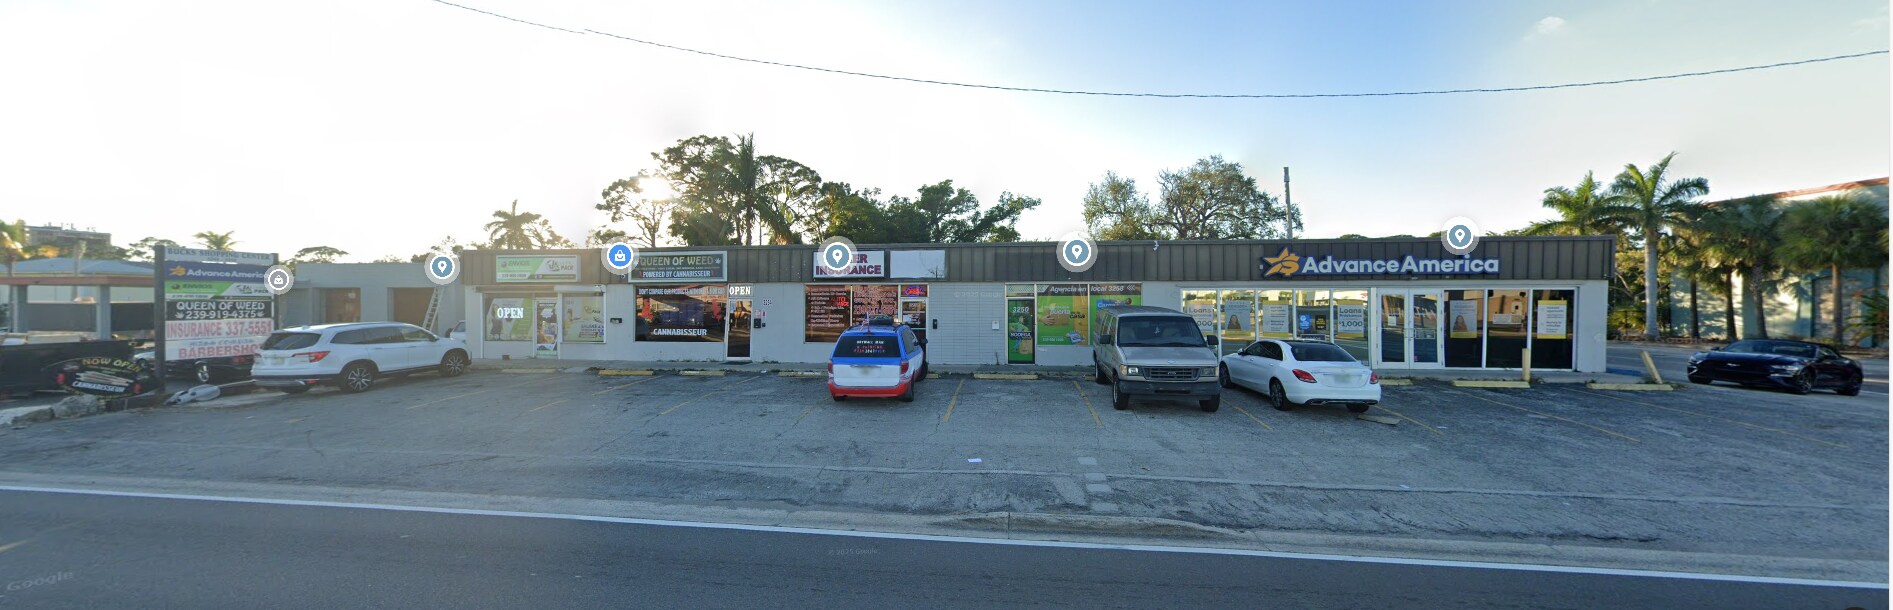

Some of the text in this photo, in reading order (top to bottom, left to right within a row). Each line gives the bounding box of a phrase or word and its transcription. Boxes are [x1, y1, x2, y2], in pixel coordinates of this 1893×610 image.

[168, 247, 196, 256] BUCKS
[199, 249, 240, 259] SHOPPING
[241, 252, 271, 260] CENTER
[640, 255, 714, 266] QUEEN OF WEED
[673, 270, 711, 278] CANNABISSEUR
[729, 286, 751, 295] OPEN
[176, 301, 265, 311] QUEEN OF WEED
[186, 310, 257, 319] 239-919-4375
[496, 307, 524, 319] OPEN
[167, 319, 273, 338] INSURANCE 337-5551
[653, 328, 708, 336] CANNABISSEUR
[178, 344, 263, 359] BARBERSHO
[113, 359, 142, 372] OPEN
